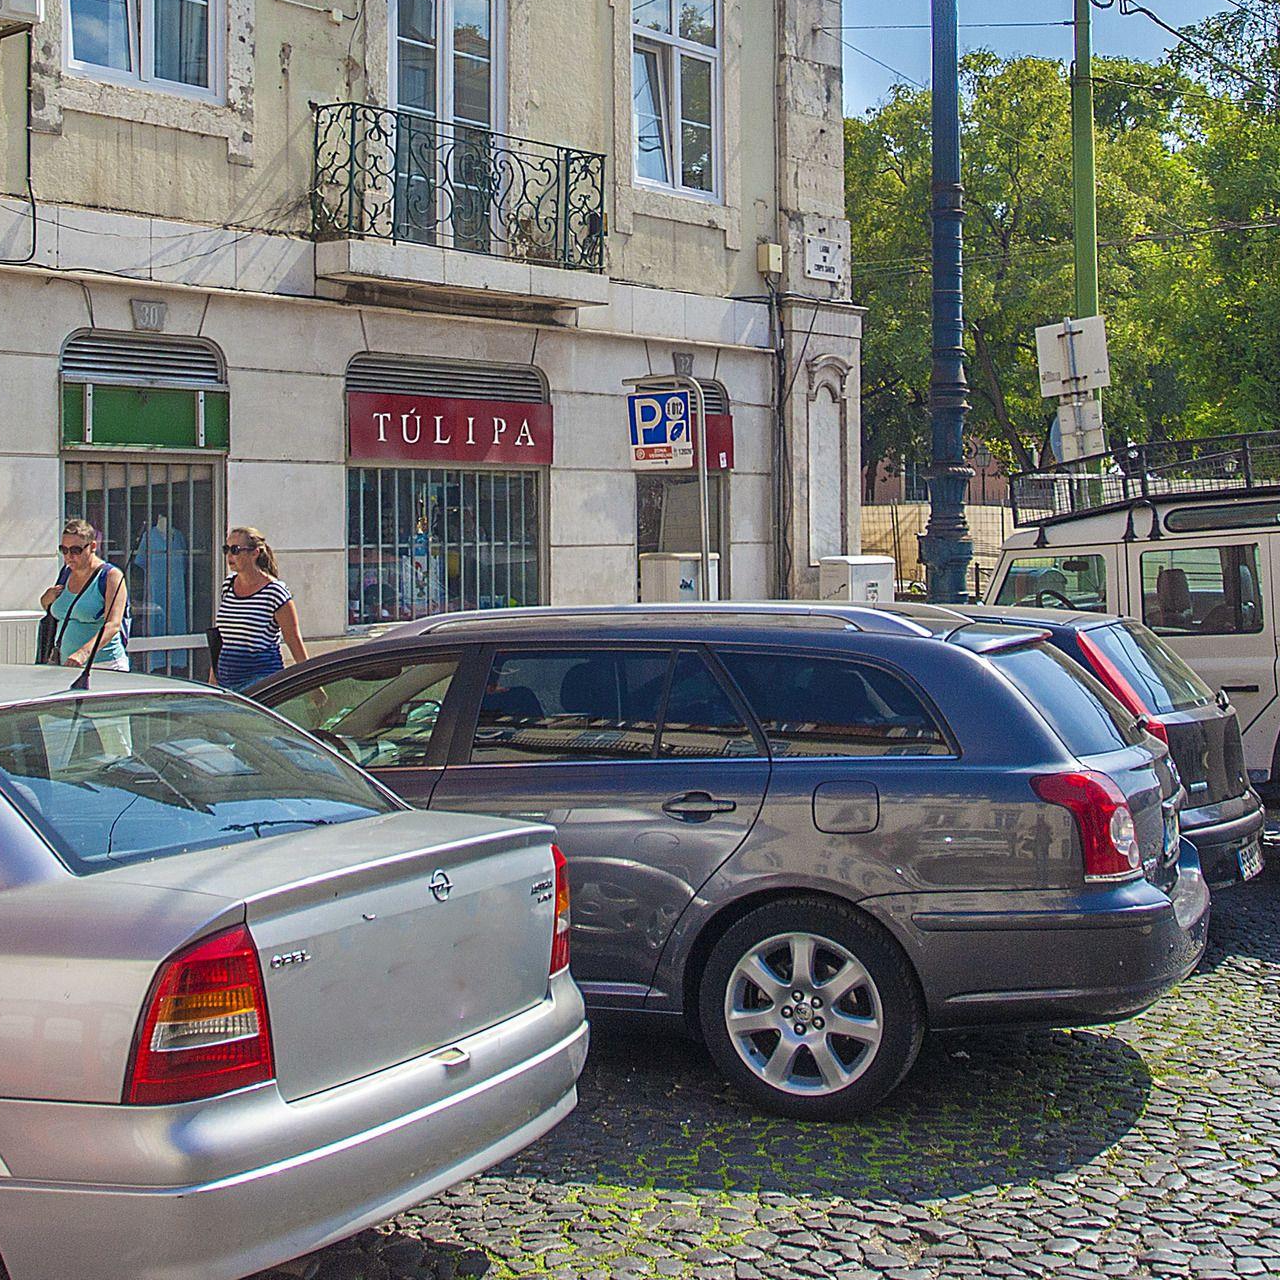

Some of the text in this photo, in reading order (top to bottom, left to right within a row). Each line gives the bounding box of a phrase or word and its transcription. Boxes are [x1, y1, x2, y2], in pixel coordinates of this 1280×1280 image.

[141, 304, 159, 326] 30
[372, 407, 535, 447] TÚLIPA
[634, 398, 662, 445] P
